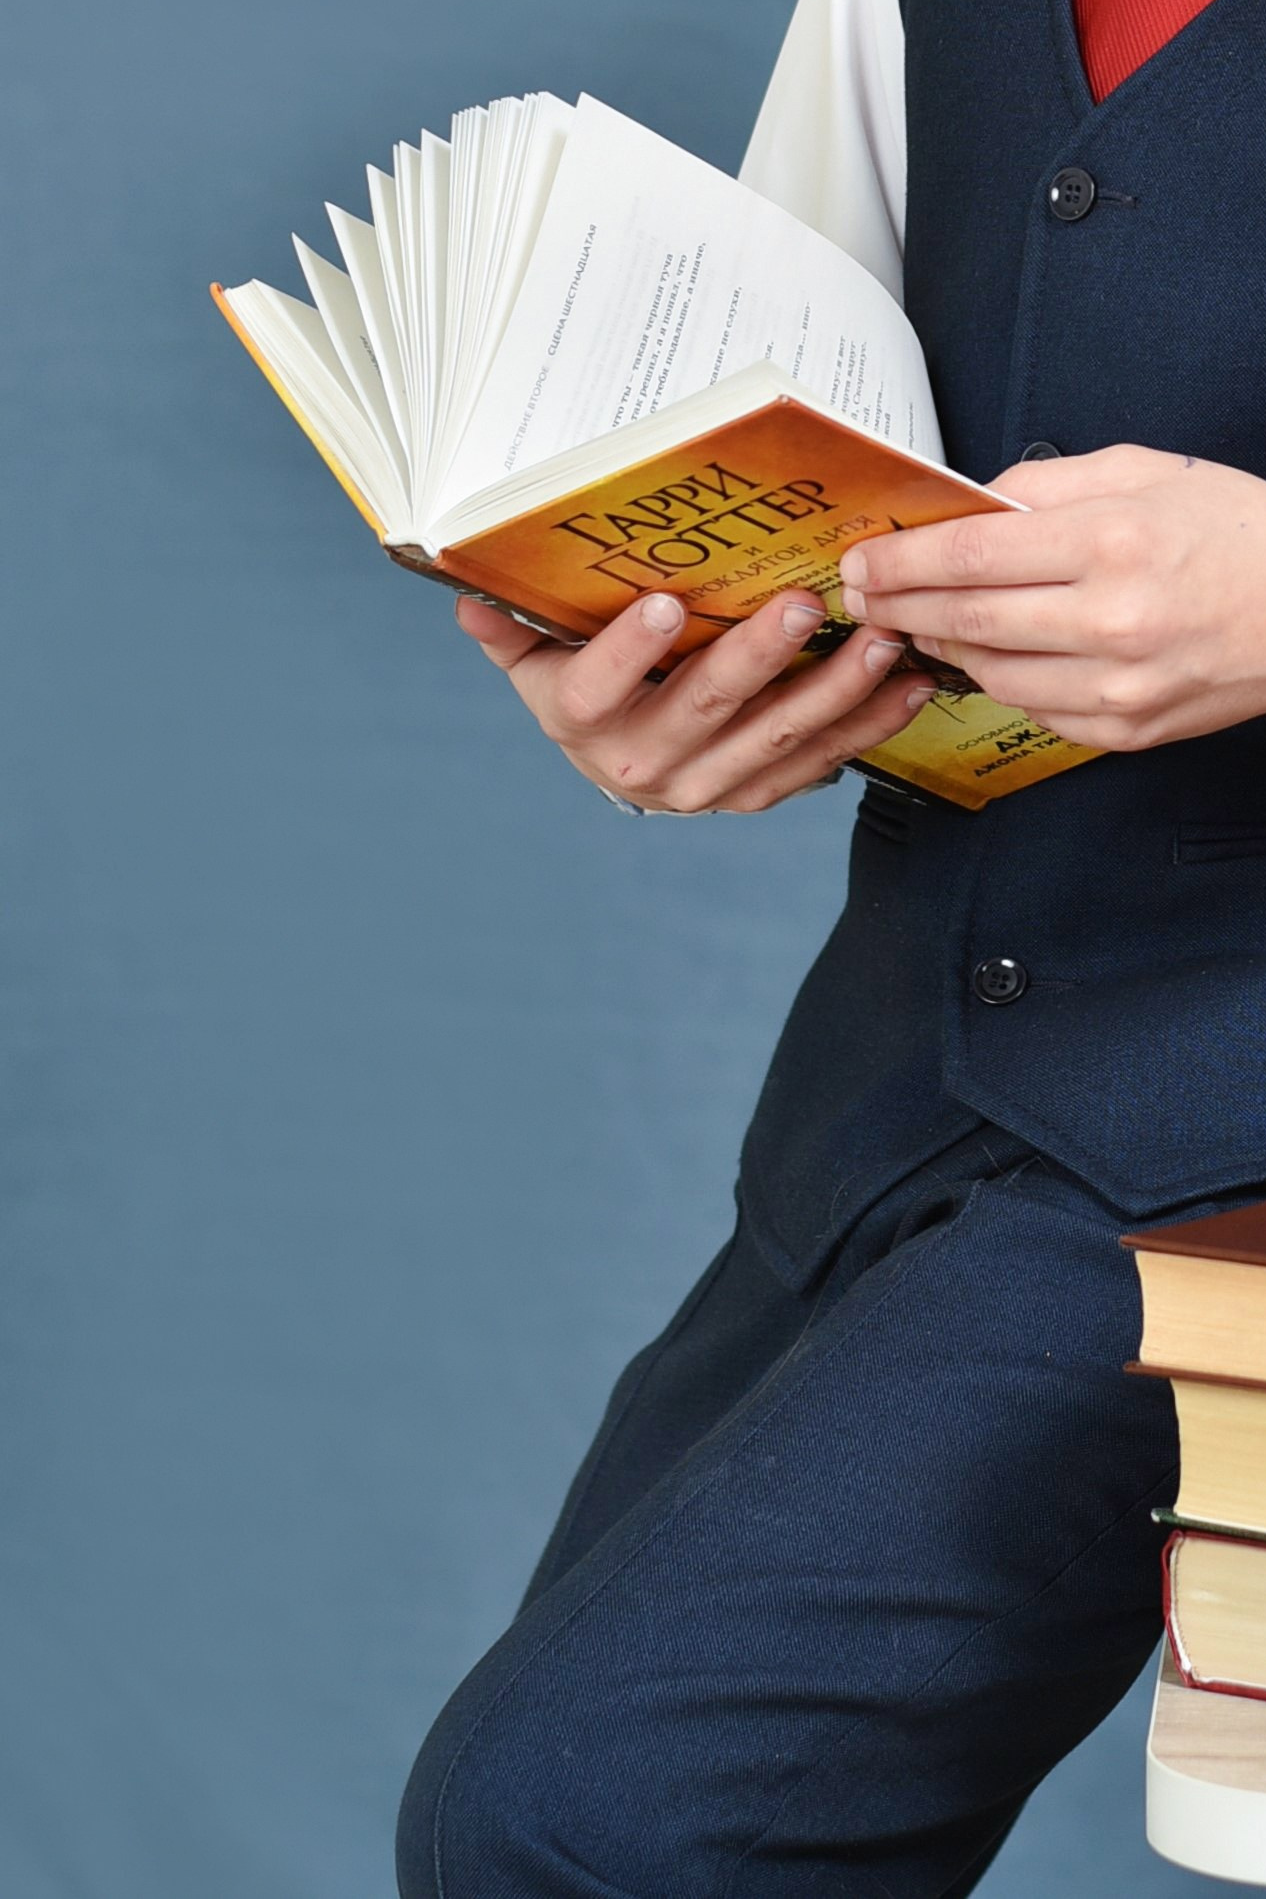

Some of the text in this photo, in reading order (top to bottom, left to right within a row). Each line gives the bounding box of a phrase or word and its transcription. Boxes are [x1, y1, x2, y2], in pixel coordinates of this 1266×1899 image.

[675, 253, 688, 277] что
[526, 364, 551, 411] ВТОРОЕ
[547, 318, 568, 357] СЦЕНА
[561, 223, 598, 317] ШЕСТНАДЦАТАЯ
[620, 384, 633, 404] ты
[631, 333, 650, 372] такая
[644, 284, 665, 332] черная
[659, 253, 674, 283] туча
[659, 326, 668, 337] я
[720, 329, 730, 347] не
[725, 286, 743, 329] слухи,
[654, 367, 671, 397] тебя
[686, 286, 695, 296] а
[656, 338, 664, 348] а
[638, 349, 662, 399] решил,
[630, 397, 644, 421] так
[550, 461, 763, 553] ГАРРИ
[584, 478, 840, 595] ПОТТЕР
[812, 514, 878, 548] ДИТЯ
[956, 720, 1024, 751] ОСНОВАНО
[973, 747, 1035, 778] ДЖОНА
